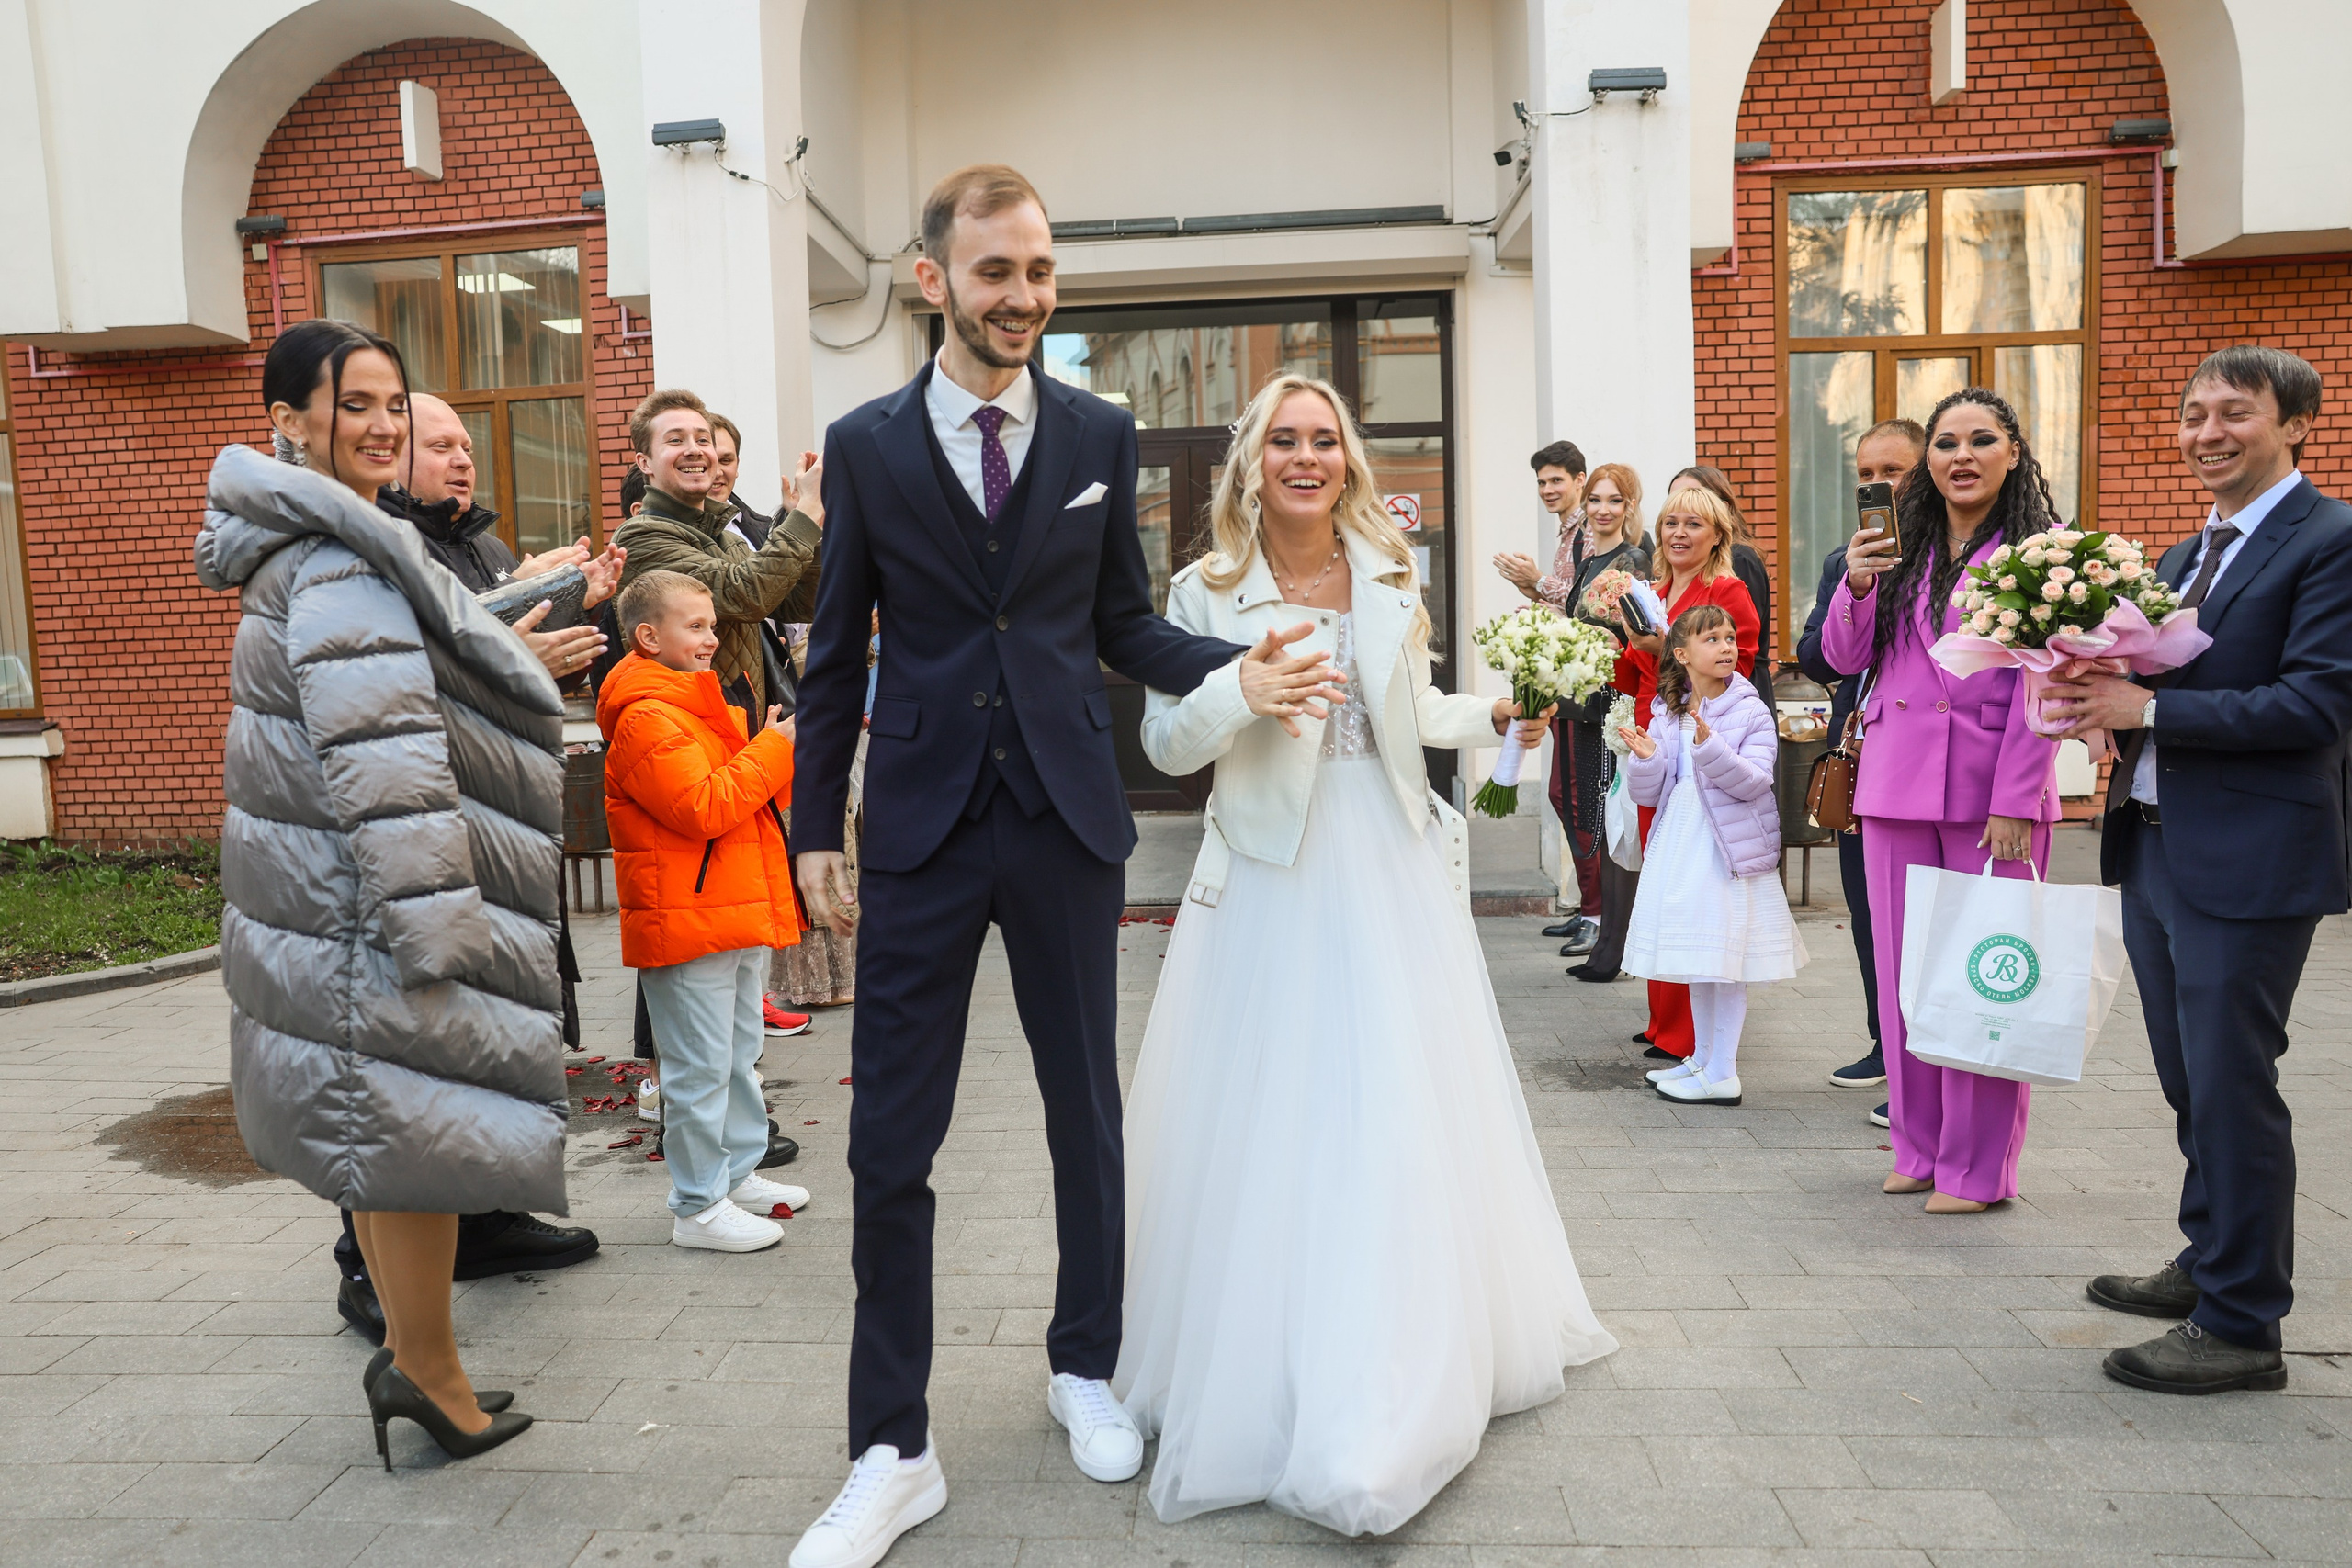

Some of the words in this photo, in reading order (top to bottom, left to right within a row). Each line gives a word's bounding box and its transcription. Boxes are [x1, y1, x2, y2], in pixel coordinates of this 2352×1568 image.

[1973, 938, 2010, 959] РЕСТОРАН
[2014, 941, 2036, 966] БРОСКО
[1970, 964, 1985, 991] БРОСКО
[1986, 990, 2011, 999] ОТЕЛЬ
[2014, 975, 2036, 998] МОСКВА
